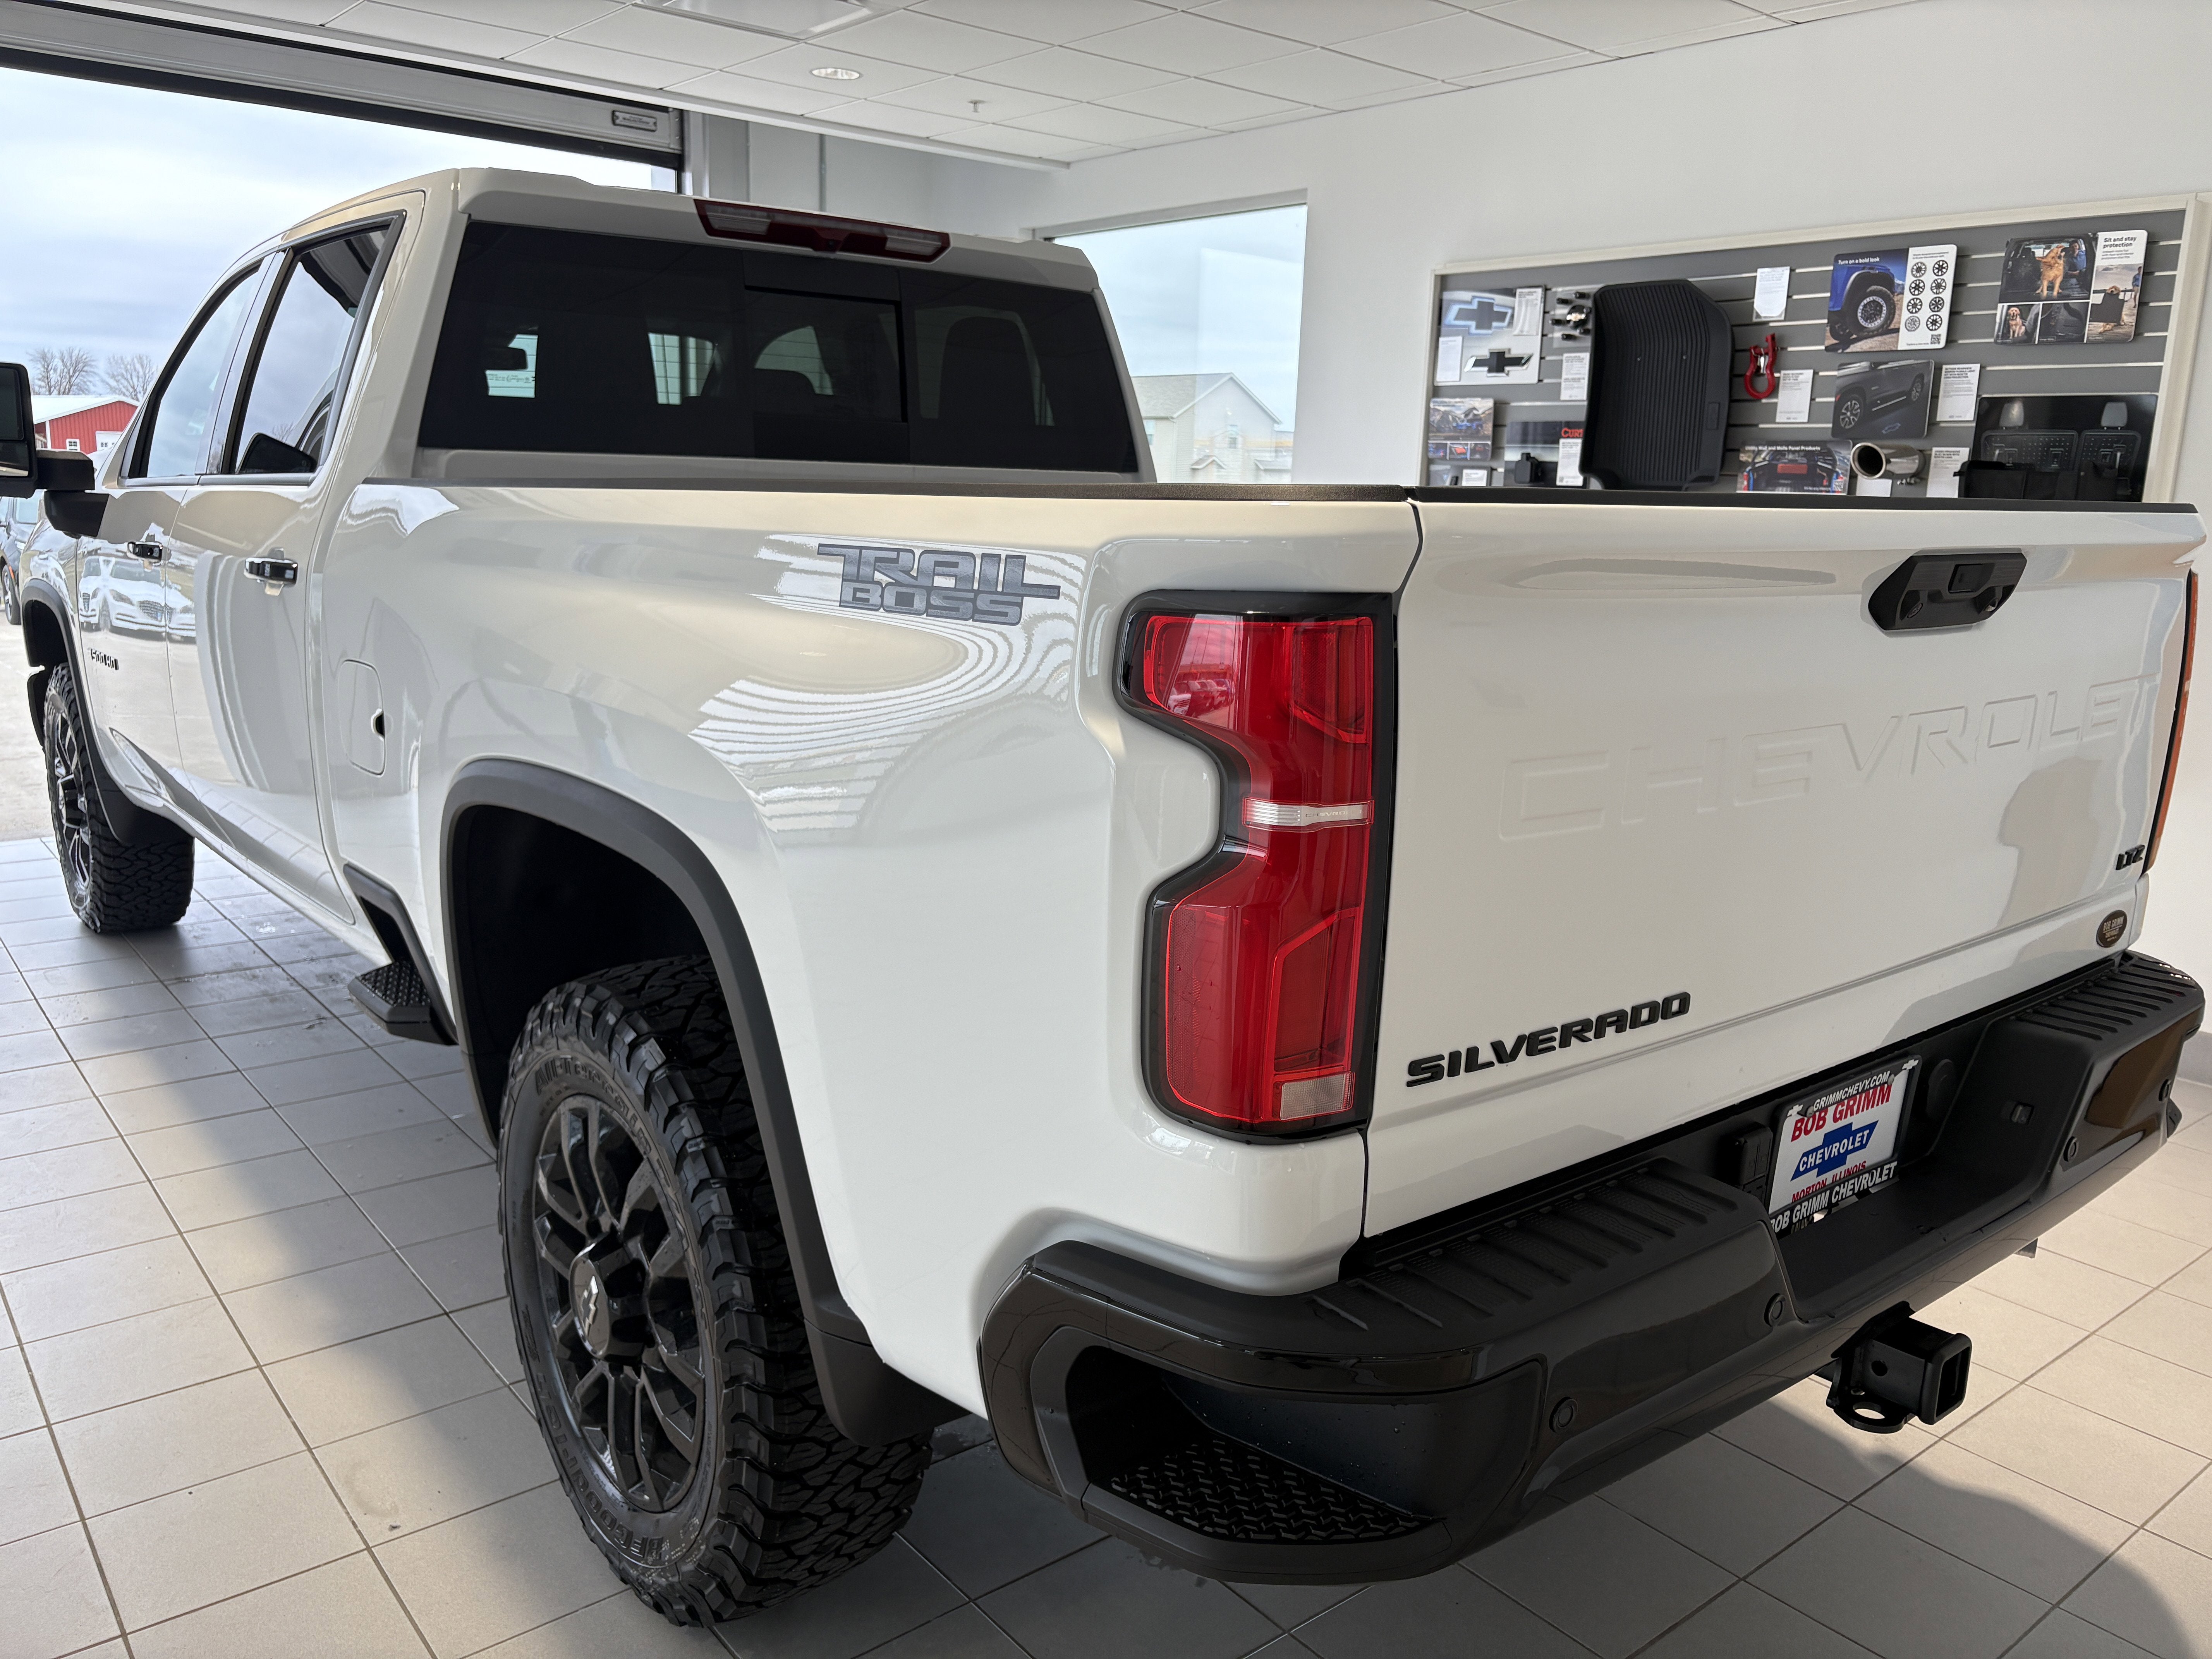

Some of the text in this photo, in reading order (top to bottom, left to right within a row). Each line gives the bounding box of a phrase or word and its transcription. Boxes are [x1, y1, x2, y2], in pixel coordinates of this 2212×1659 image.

[817, 543, 1061, 600] TRAIL
[839, 580, 1024, 626] BOSS
[2115, 844, 2145, 871] LTZ
[1406, 992, 1691, 1087] SILVERADO
[1791, 1084, 1893, 1142] BOB GRIMM
[1813, 1070, 1890, 1111] GRIMMCHEVY.COM
[1799, 1129, 1870, 1172] CHEVROLET
[1791, 1178, 1827, 1203] MORTON
[1793, 1190, 1829, 1223] GRIMM
[1831, 1161, 1898, 1203] CHEVROLET
